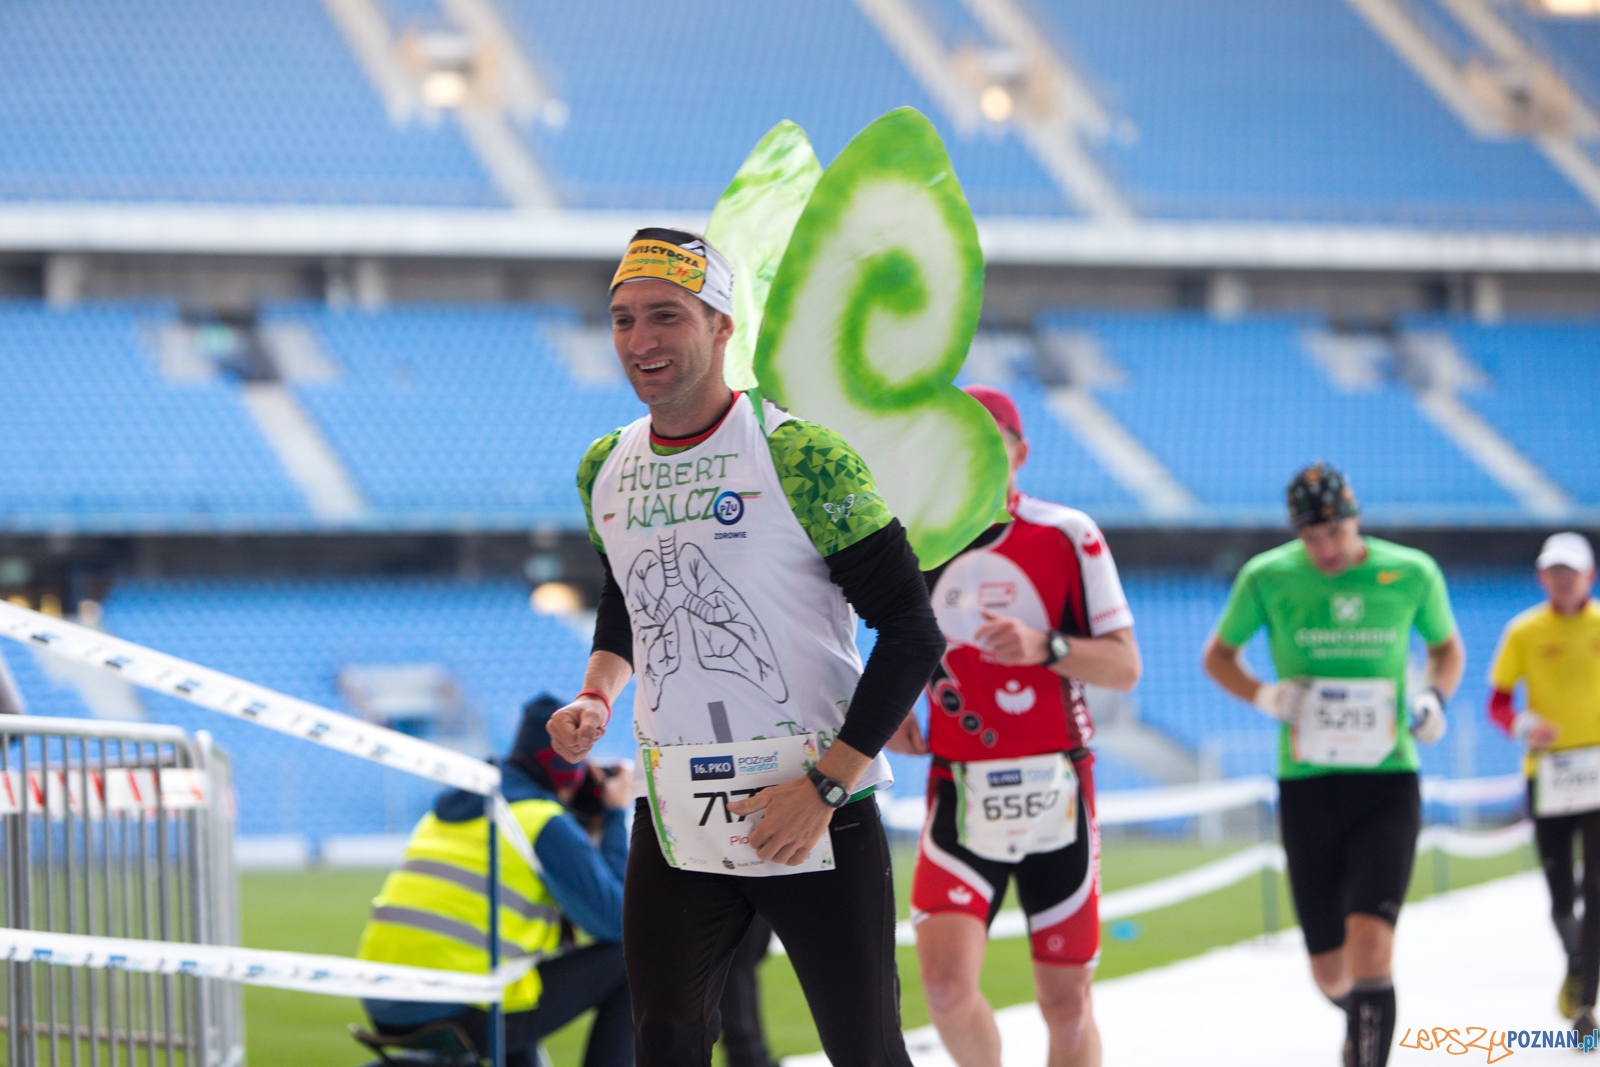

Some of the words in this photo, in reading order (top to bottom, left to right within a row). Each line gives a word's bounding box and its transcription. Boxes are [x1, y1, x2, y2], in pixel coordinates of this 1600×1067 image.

[618, 453, 739, 493] HUBERT
[719, 501, 738, 516] PZU
[713, 531, 748, 541] ZDROWIE
[693, 762, 732, 774] 16.PKO
[738, 762, 779, 773] maraton
[693, 784, 780, 826] 717
[729, 835, 750, 847] Pio
